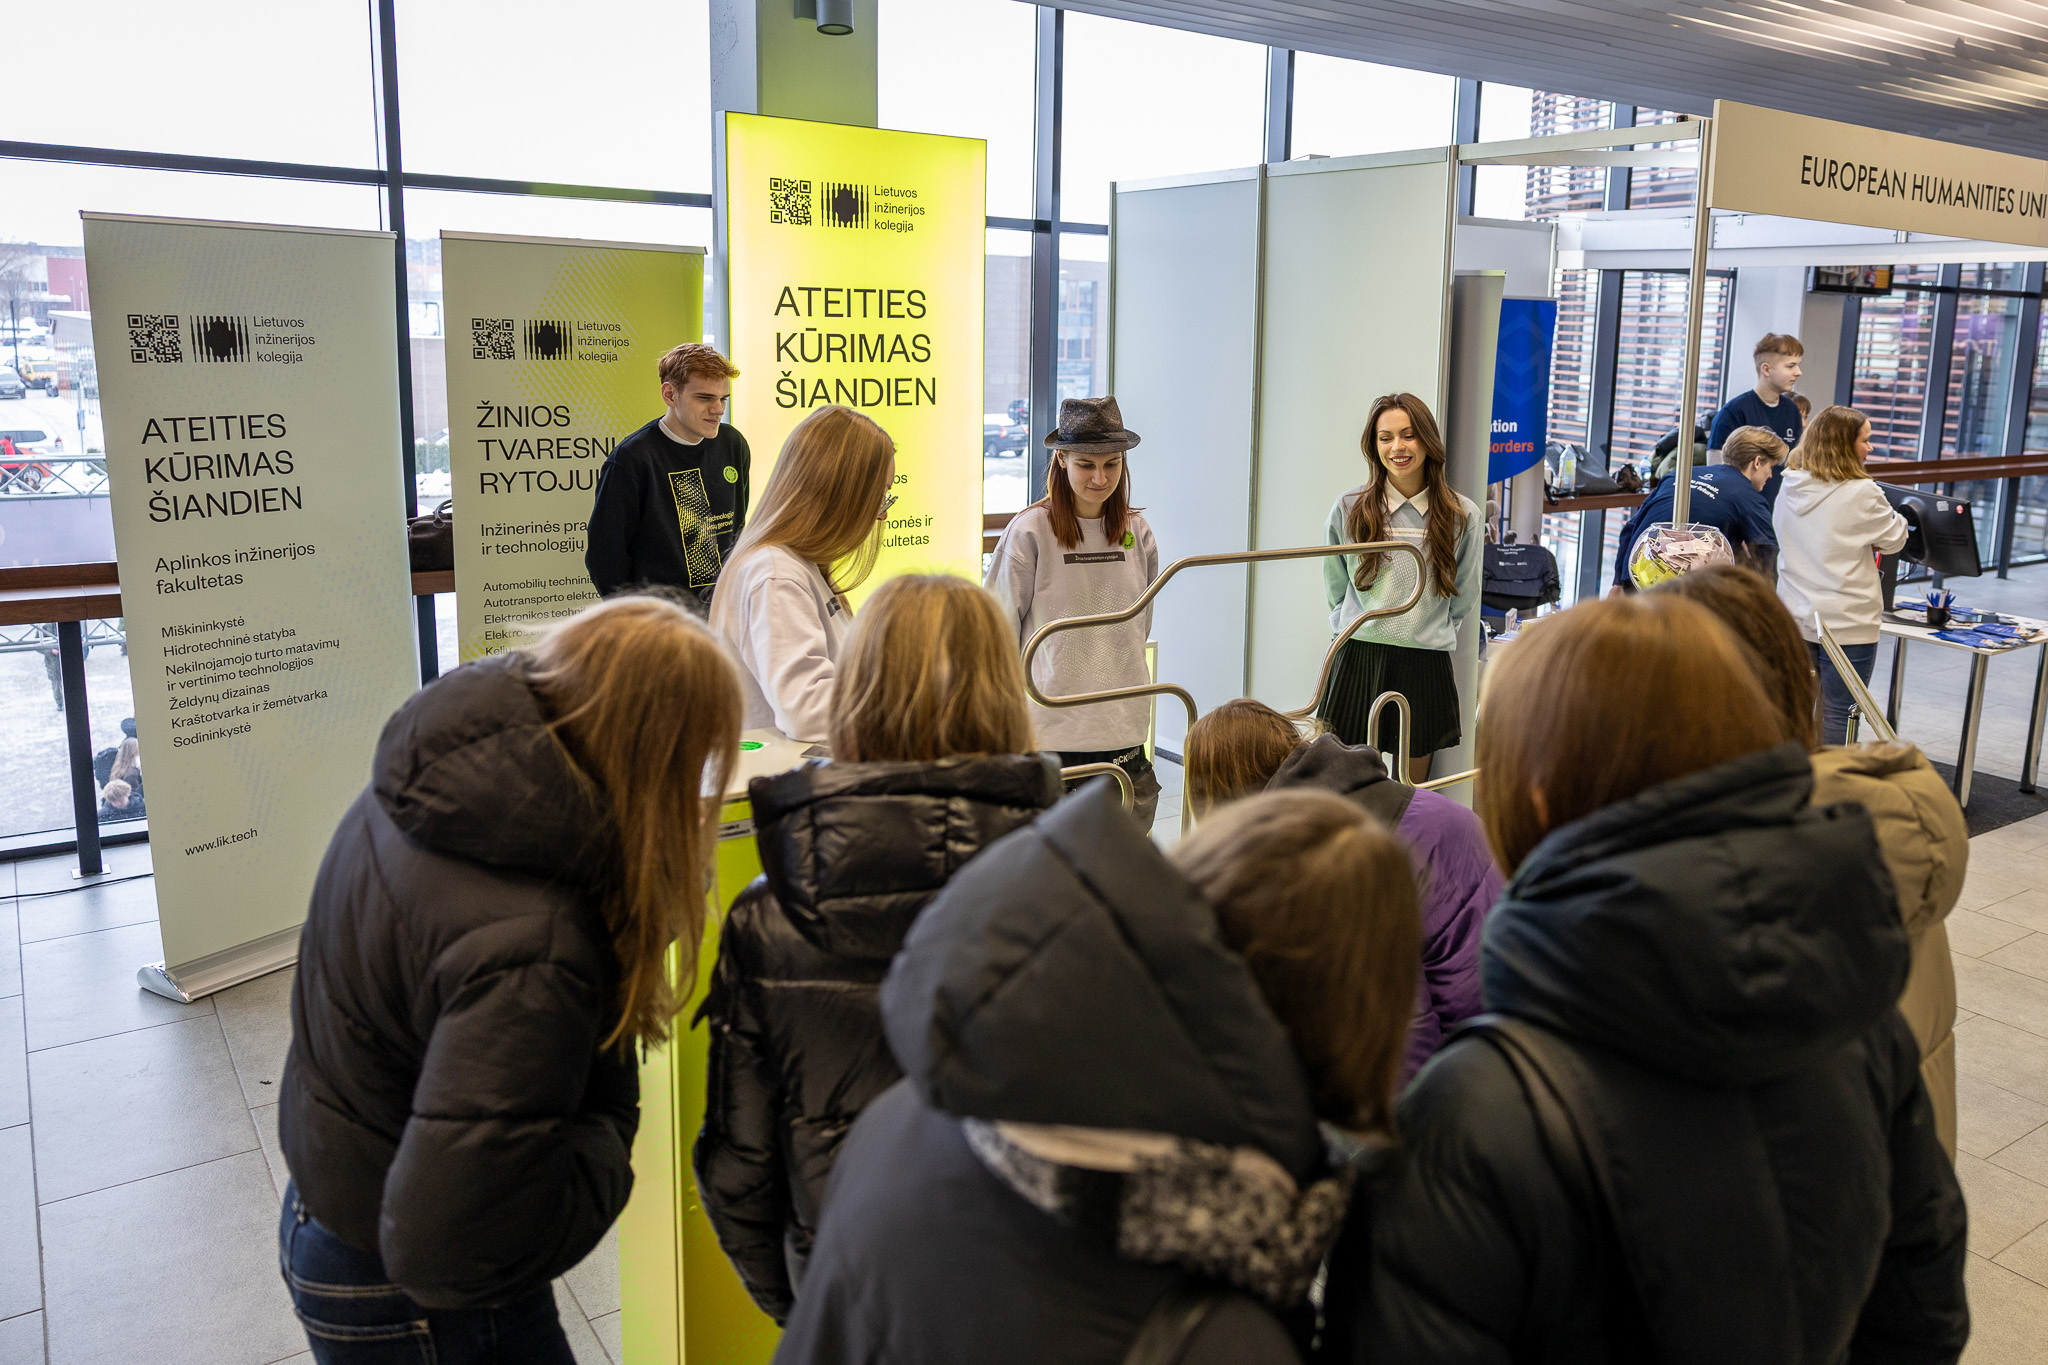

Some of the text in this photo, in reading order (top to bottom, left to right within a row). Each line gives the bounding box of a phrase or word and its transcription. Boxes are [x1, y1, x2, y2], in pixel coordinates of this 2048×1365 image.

[874, 185, 918, 198] Lietuvos
[1800, 154, 2048, 219] EUROPEAN HUMANITIES UNI
[874, 202, 925, 216] inžinerijos
[874, 220, 914, 233] kolegija
[774, 286, 927, 319] ATEITIES
[253, 316, 304, 328] Lietuvos
[577, 321, 621, 332] Lietuvos
[255, 333, 316, 348] inžinerijos
[578, 335, 630, 348] inžinerijos
[776, 328, 932, 363] KŪRIMAS
[256, 351, 304, 364] kolegija
[578, 352, 618, 363] kolegija
[775, 370, 936, 408] ŠIANDIEN
[476, 400, 571, 428] ŽINIOS
[141, 414, 286, 444] ATEITIES
[477, 437, 616, 461] TVARESNI
[144, 450, 294, 484] KŪRIMAS
[148, 486, 302, 522] ŠIANDIEN
[481, 520, 588, 537] Inžinerinės pra
[925, 514, 934, 526] ir
[482, 537, 584, 555] ir technologijų
[155, 543, 316, 574] Aplinkos inžinerijos
[156, 574, 244, 594] fakultetas
[483, 579, 547, 592] Automobilių
[484, 591, 601, 608] Autotransporto elektro
[161, 616, 245, 638] Miškininkystė
[484, 607, 586, 625] Elektronikos techni
[163, 627, 296, 657] Hidrotechninė statyba
[166, 639, 340, 676] Nekilnojamojo turto matavimų
[167, 657, 314, 692] ir vertinimo technologijos
[169, 683, 270, 710] Želdynų dizainas
[171, 689, 328, 729] Kraštotvarka ir žemėtvarka
[173, 722, 252, 748] Sodininkystė
[185, 828, 258, 856] www.lik.tech
